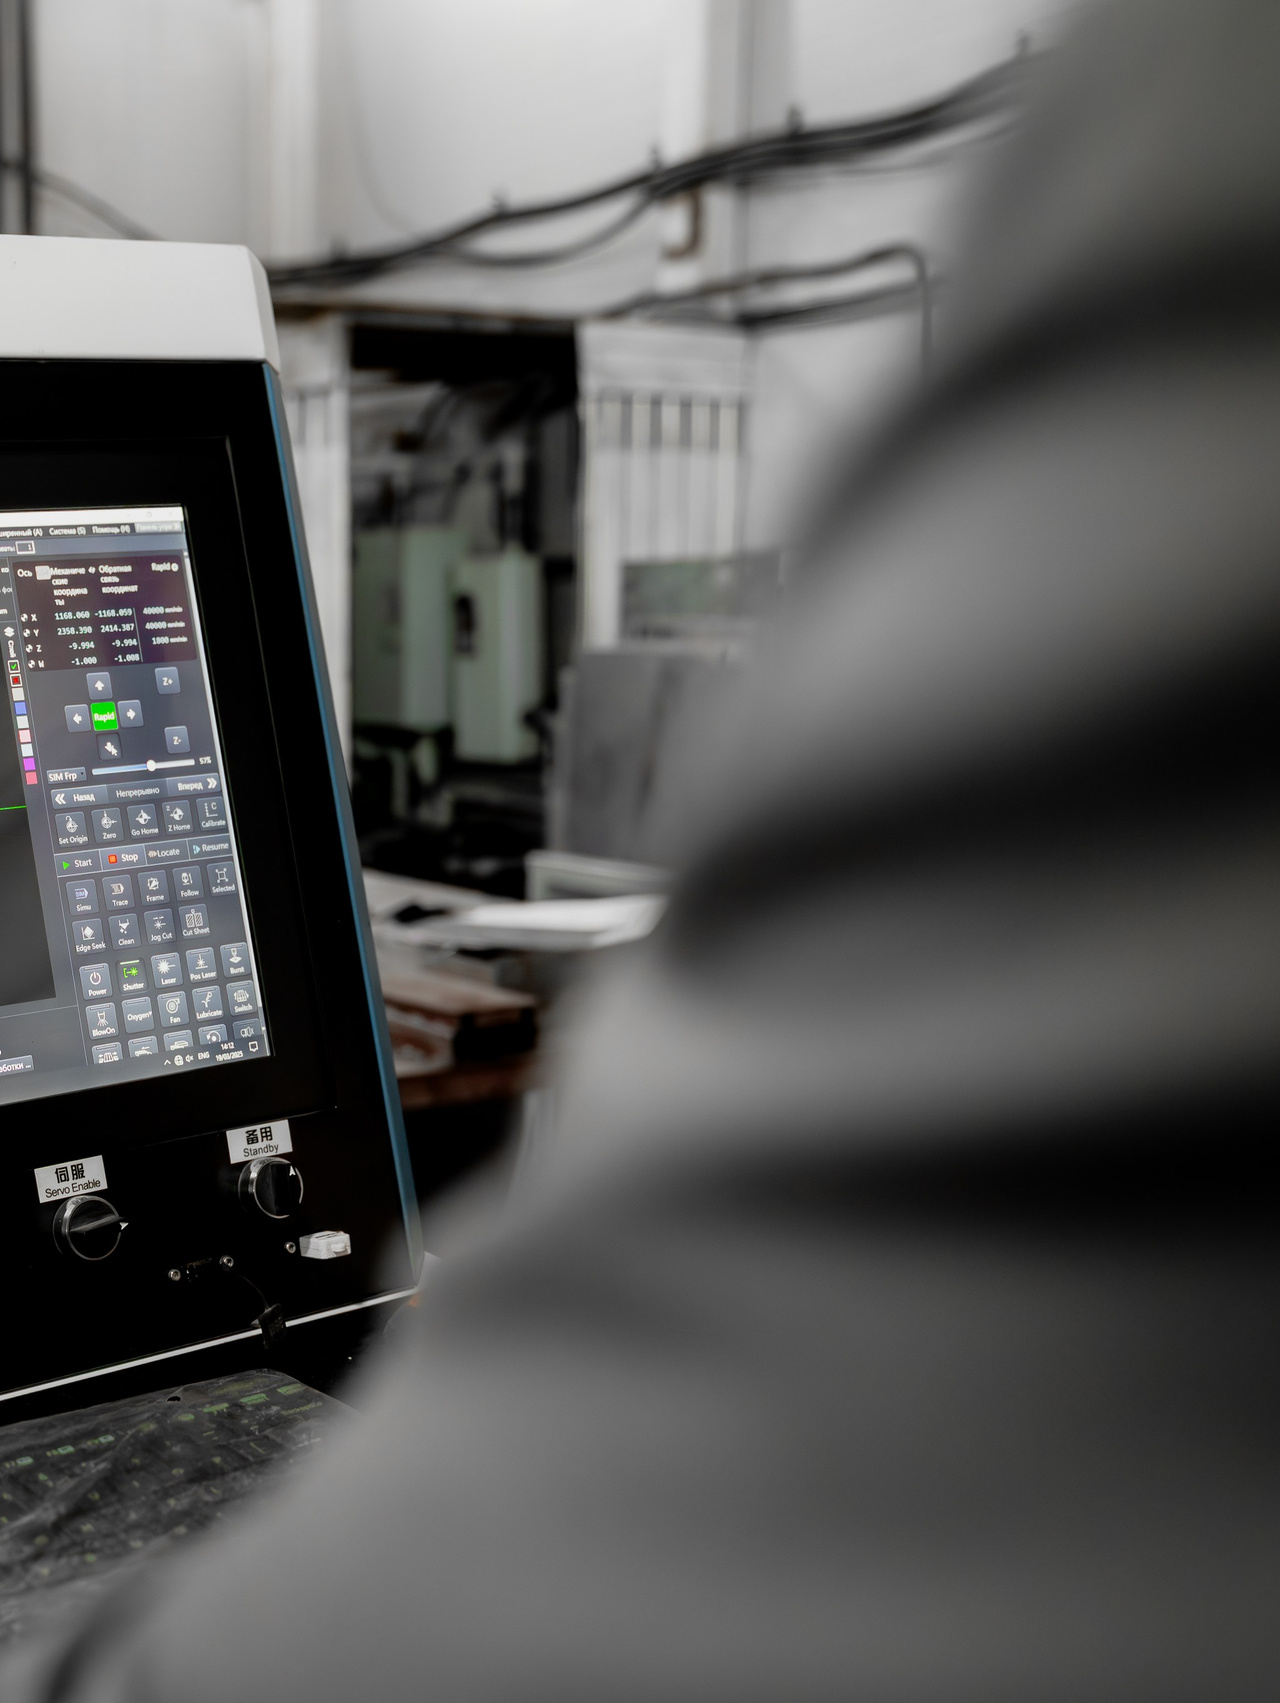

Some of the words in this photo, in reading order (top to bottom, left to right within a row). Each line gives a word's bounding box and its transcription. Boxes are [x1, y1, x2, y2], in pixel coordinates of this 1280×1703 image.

[49, 527, 75, 536] Система
[92, 526, 119, 534] Помощь
[51, 566, 85, 575] Механиче
[99, 565, 132, 574] Обратная
[151, 562, 170, 571] Rapid
[17, 569, 32, 577] Ось
[100, 575, 119, 583] связь
[53, 587, 88, 597] координа
[102, 585, 138, 594] координат
[55, 611, 90, 620] 1168.060
[94, 608, 132, 618] -1168.059
[33, 629, 39, 637] Y
[57, 626, 92, 635] 2358.390
[100, 623, 134, 632] 2414.387
[68, 641, 95, 651] -9.994
[112, 638, 137, 648] -9.994
[71, 656, 97, 666] -1.000
[94, 712, 115, 722] Rapid
[48, 773, 62, 781] SIM
[178, 781, 203, 791] Вперед
[73, 793, 95, 802] Назад
[116, 787, 160, 799] Непрерывно
[174, 823, 190, 831] Home
[202, 819, 226, 828] Calibrate
[140, 827, 158, 835] Home
[59, 836, 68, 844] Set
[70, 834, 88, 844] Origin
[157, 848, 180, 857] Locate
[202, 843, 229, 853] Resume
[75, 859, 92, 867] Start
[121, 854, 138, 863] Stop
[181, 889, 199, 897] Follow
[212, 884, 235, 893] Selected
[147, 894, 164, 902] Frame
[193, 926, 210, 935] Sheet
[76, 944, 90, 953] Edge
[92, 942, 106, 950] Seek
[230, 966, 245, 974] Burst
[201, 971, 216, 979] Laser
[161, 977, 177, 985] Laser
[123, 982, 144, 991] Shutter
[234, 1004, 253, 1012] Switch
[128, 1013, 150, 1022] Oxygen
[196, 1010, 222, 1019] Lubricate
[92, 1027, 116, 1035] BlowOn
[198, 1052, 210, 1060] ENG
[245, 1126, 273, 1145] 备用
[243, 1144, 279, 1158] Standby
[55, 1163, 86, 1183] 伺服
[45, 1186, 70, 1198] Servo
[72, 1178, 101, 1192] Enable
